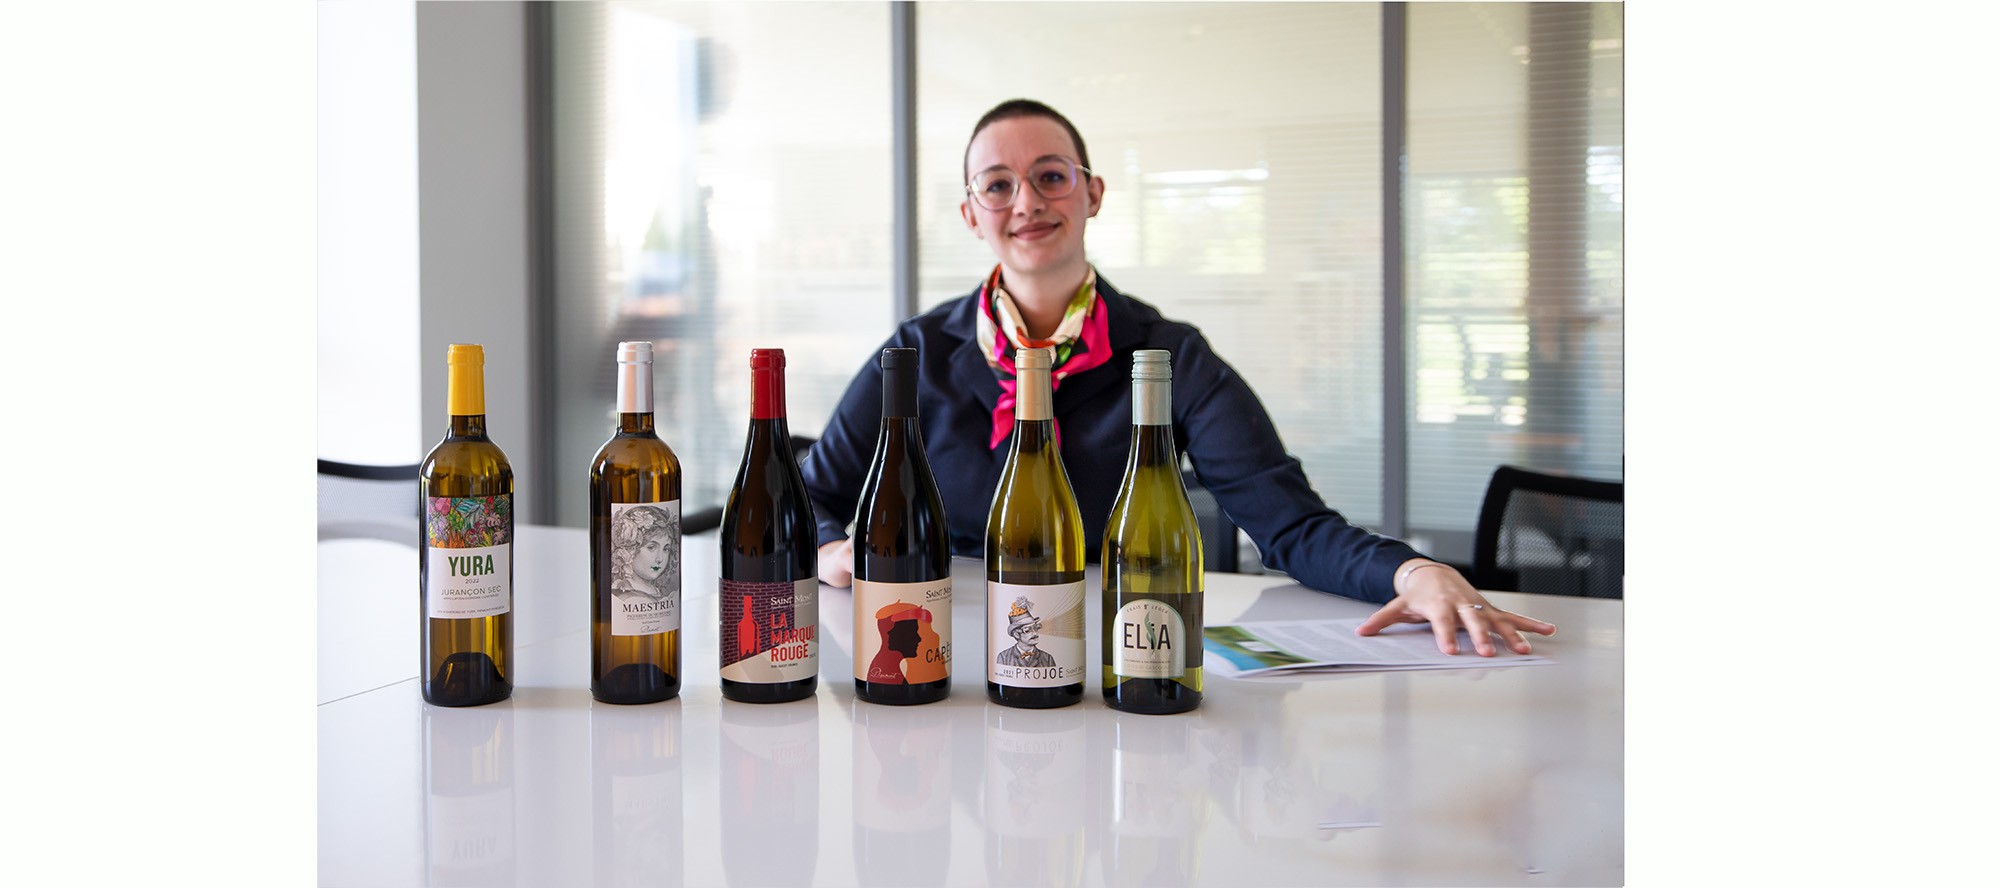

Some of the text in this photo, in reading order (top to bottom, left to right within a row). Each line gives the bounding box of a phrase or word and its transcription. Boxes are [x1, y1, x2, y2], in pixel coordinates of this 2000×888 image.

[448, 554, 494, 577] YURA
[441, 587, 486, 597] JURANÇON
[487, 585, 502, 593] SEC
[622, 600, 675, 613] MAESTRIA
[770, 595, 794, 606] SAINT
[770, 612, 787, 628] LA
[770, 624, 815, 645] MARQUE
[770, 643, 809, 662] ROUGE
[1015, 666, 1064, 680] PROJOE
